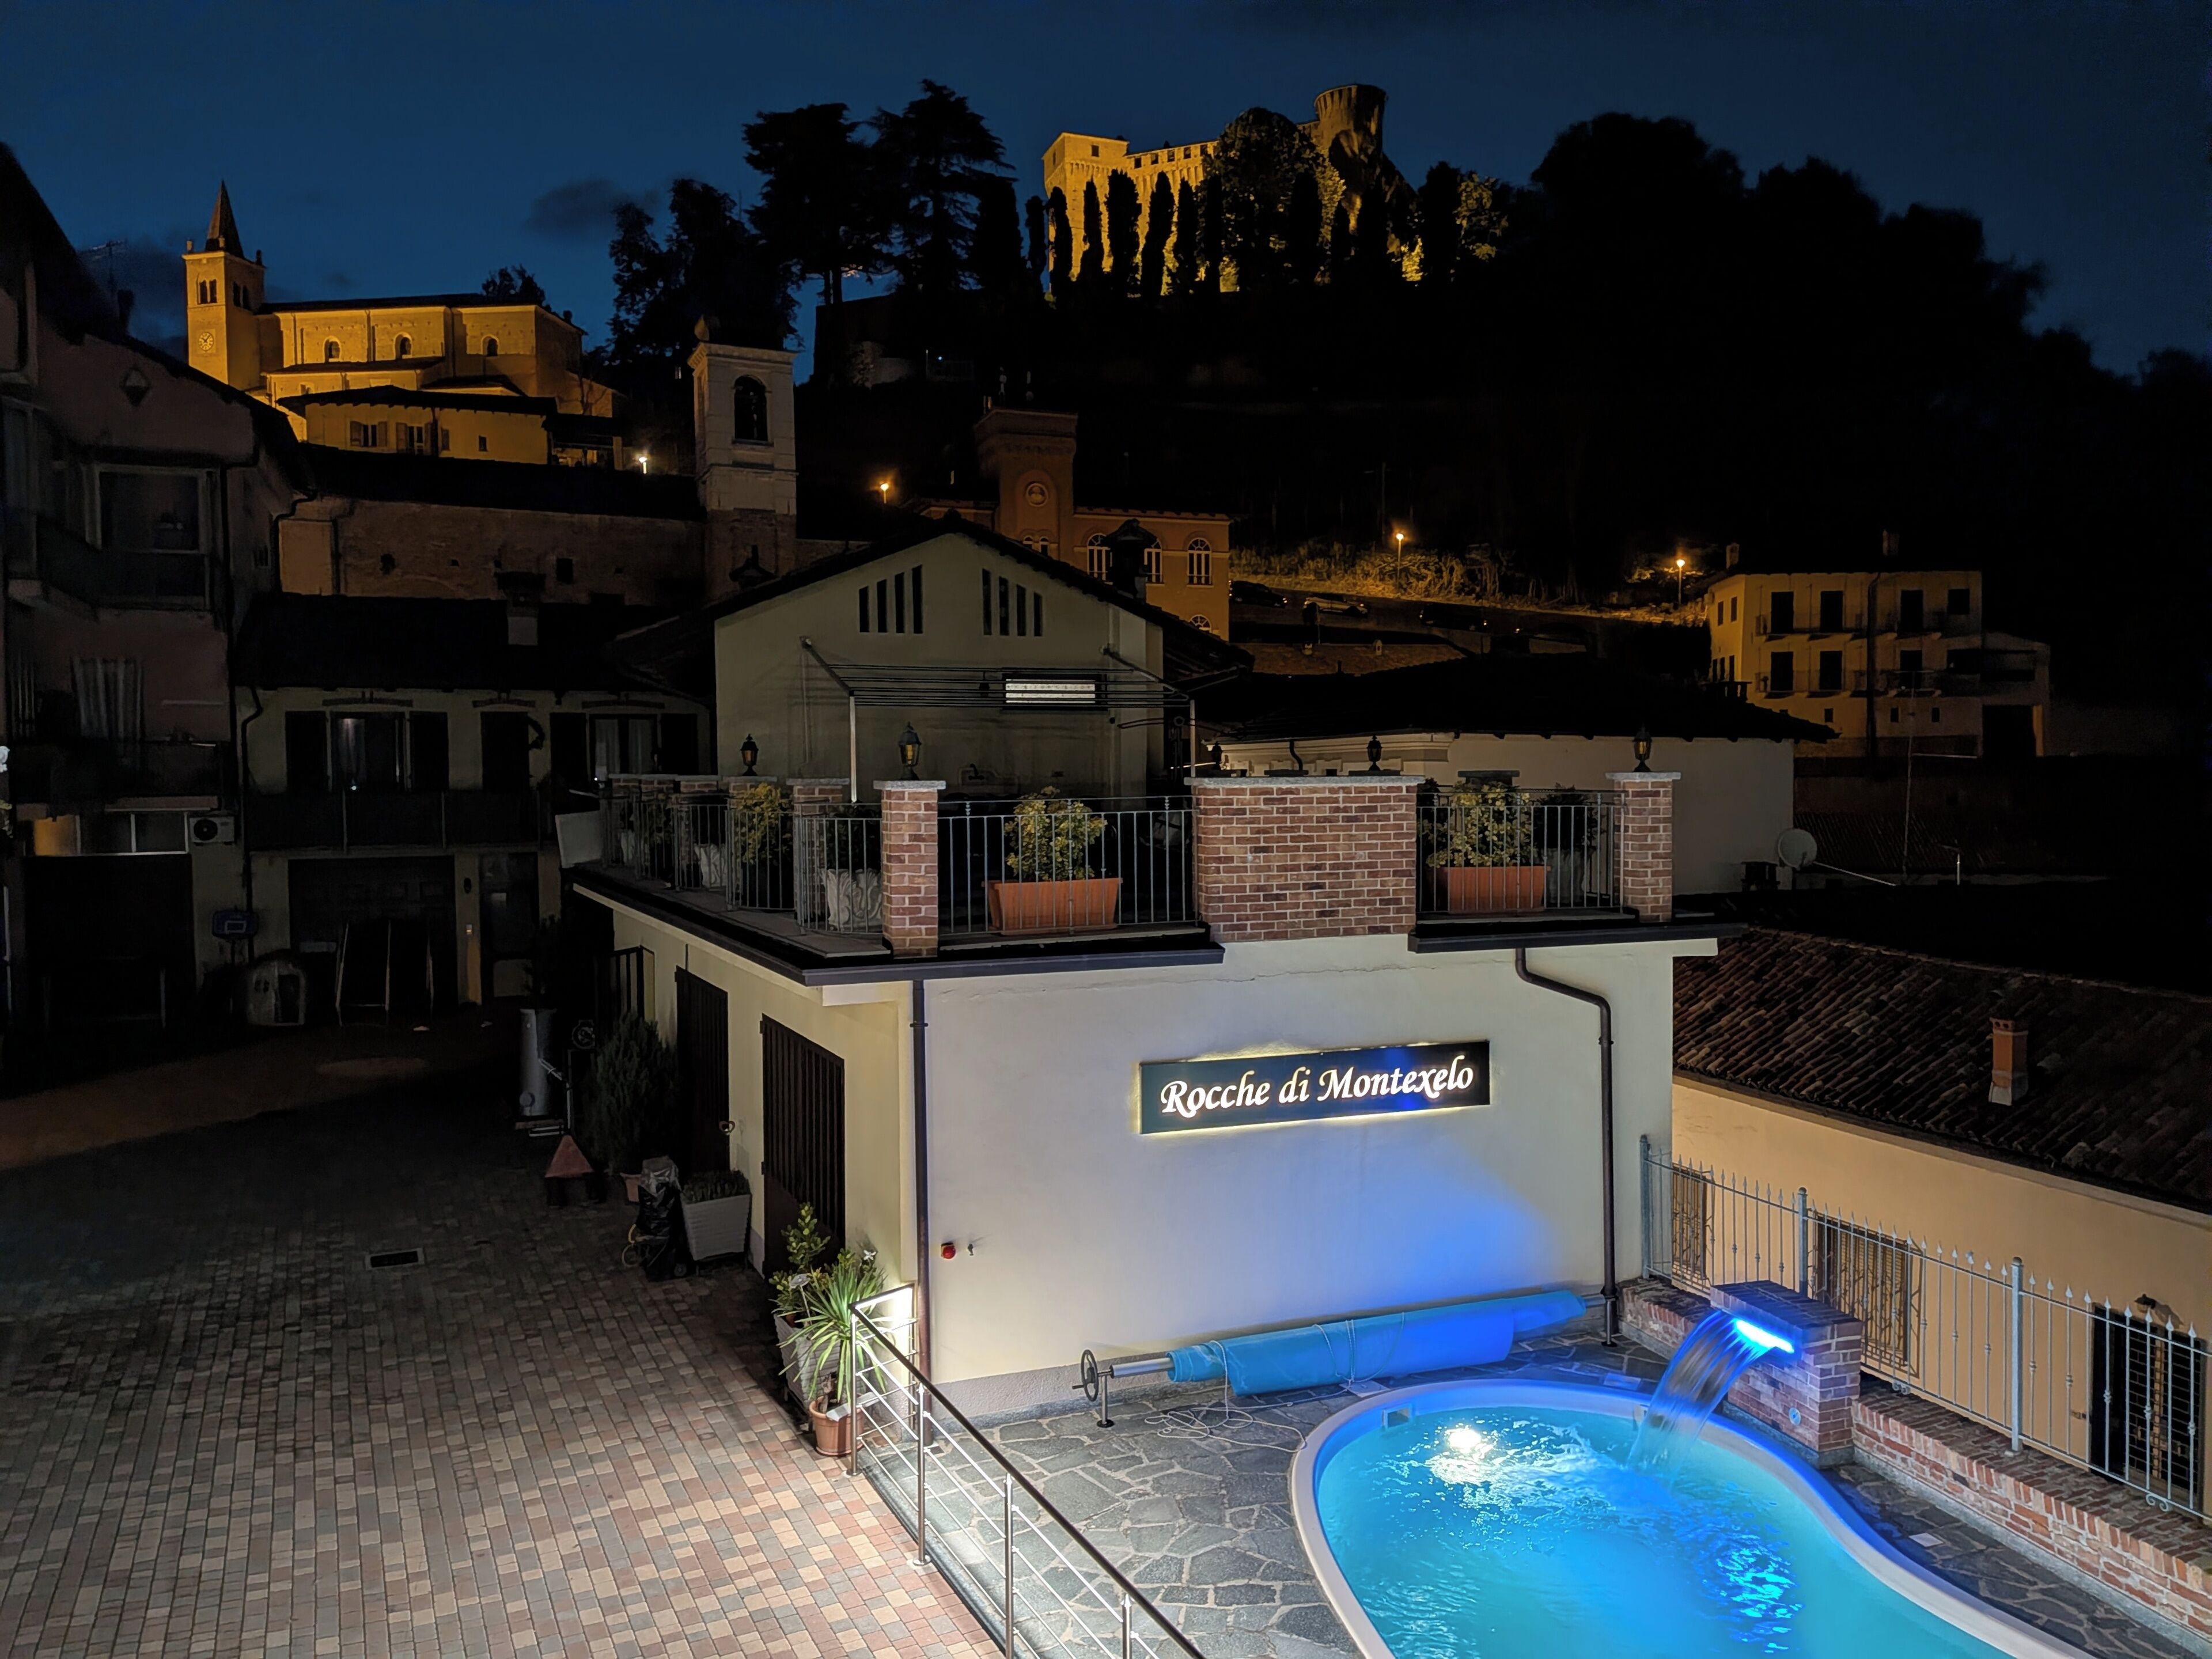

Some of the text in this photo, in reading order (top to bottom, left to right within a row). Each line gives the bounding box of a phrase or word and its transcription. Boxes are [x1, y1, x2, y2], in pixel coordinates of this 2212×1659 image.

[1160, 1055, 1474, 1119] Rocche di Montexelo
